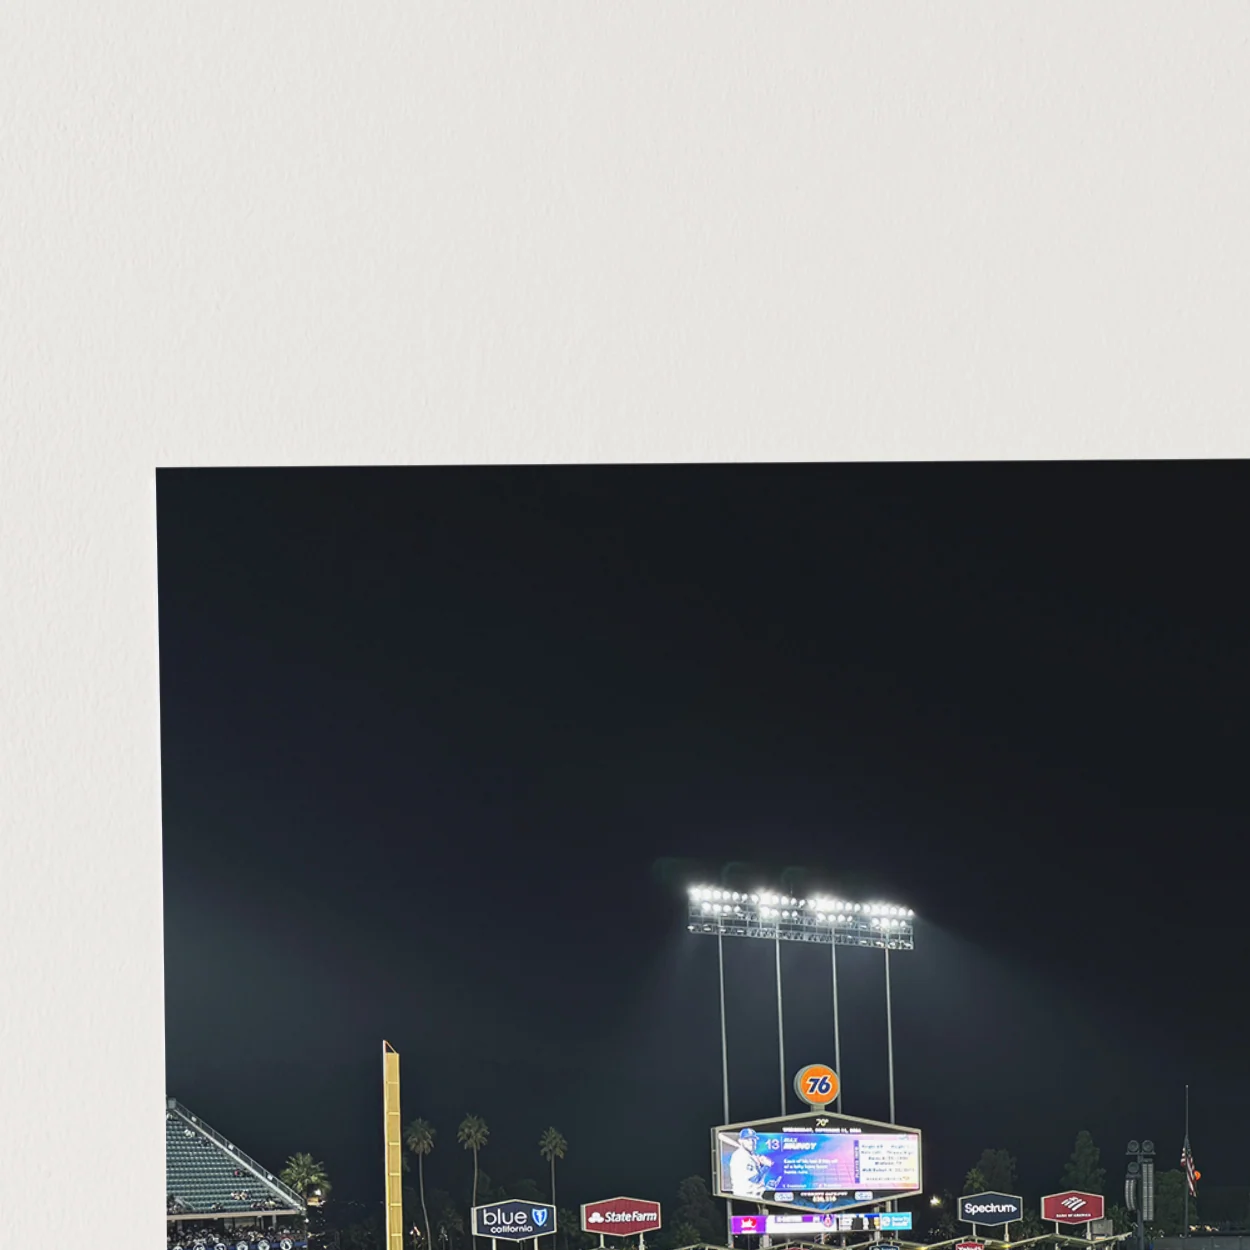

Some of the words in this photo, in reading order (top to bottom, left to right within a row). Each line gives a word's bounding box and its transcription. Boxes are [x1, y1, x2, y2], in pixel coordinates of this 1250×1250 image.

[806, 1076, 832, 1094] 76
[965, 1203, 1013, 1215] Spectrum
[483, 1208, 527, 1226] blue
[490, 1224, 533, 1234] california
